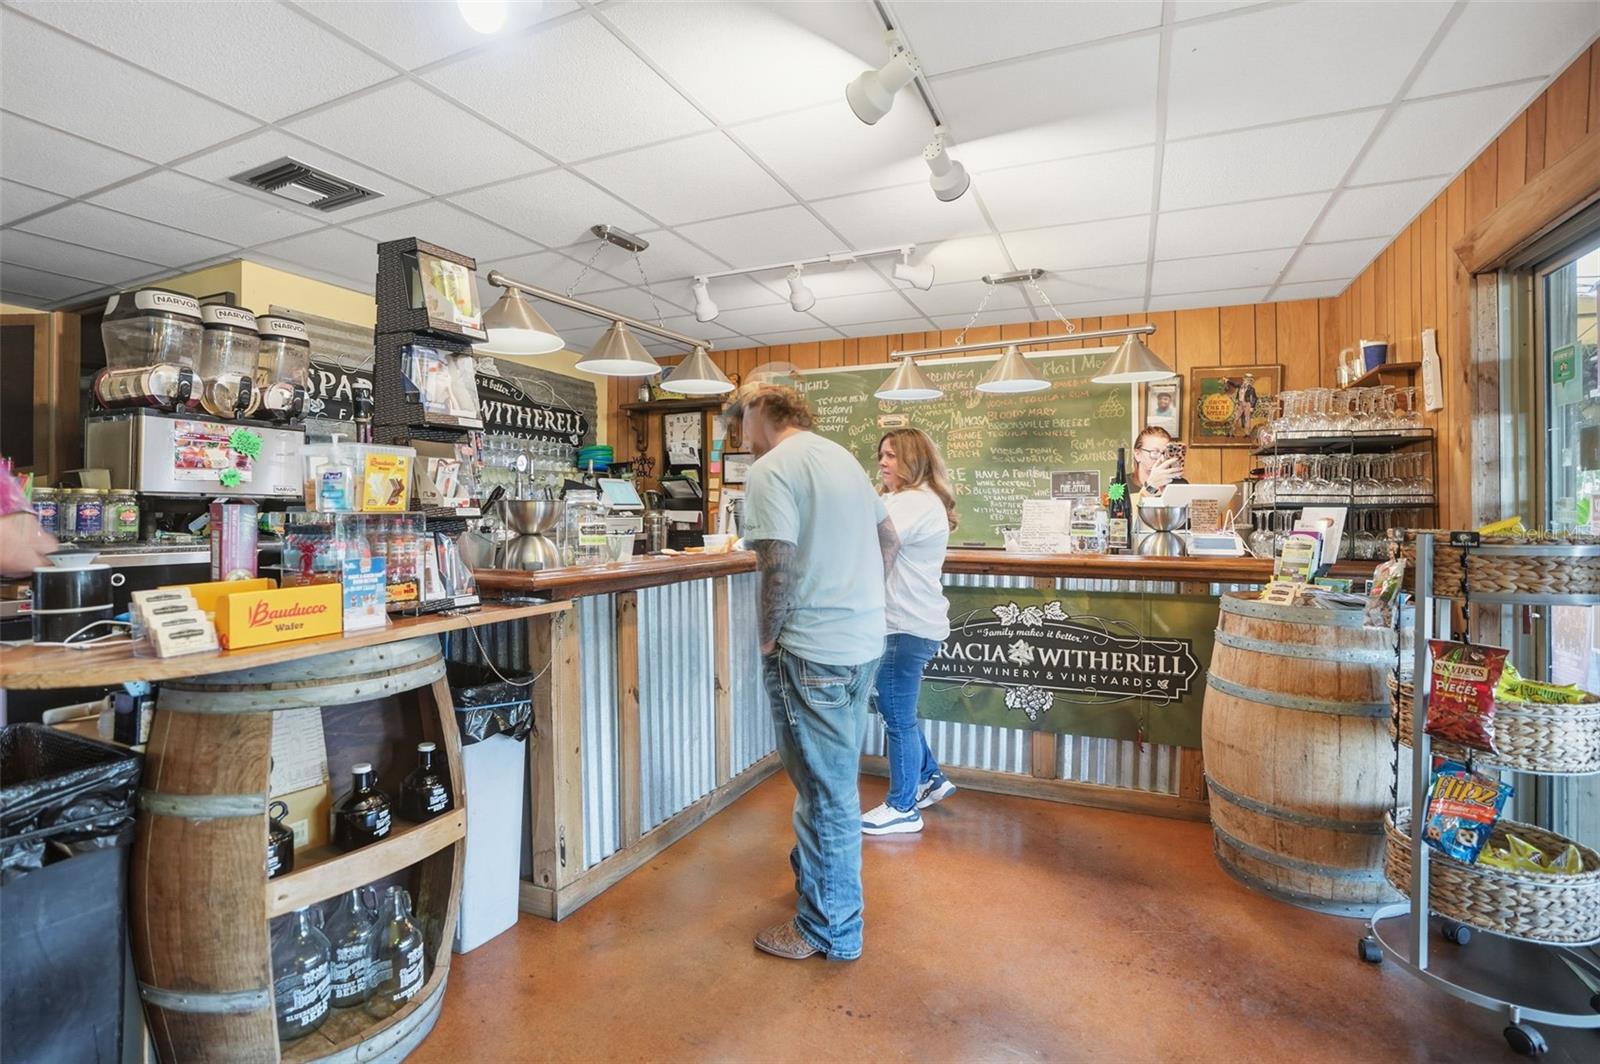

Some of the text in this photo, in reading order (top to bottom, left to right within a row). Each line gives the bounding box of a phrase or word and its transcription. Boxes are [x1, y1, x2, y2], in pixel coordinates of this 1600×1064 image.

[273, 322, 305, 333] NARVO
[481, 399, 586, 436] WITHERELL
[248, 599, 328, 629] Bauducco
[274, 623, 304, 633] Wafer
[1016, 630, 1044, 638] makes
[1046, 629, 1054, 638] it
[934, 641, 1187, 677] RACIA WITHERELL
[923, 661, 1153, 690] FAMILY WINERY & VINEYARDS
[1433, 776, 1499, 804] Flipz
